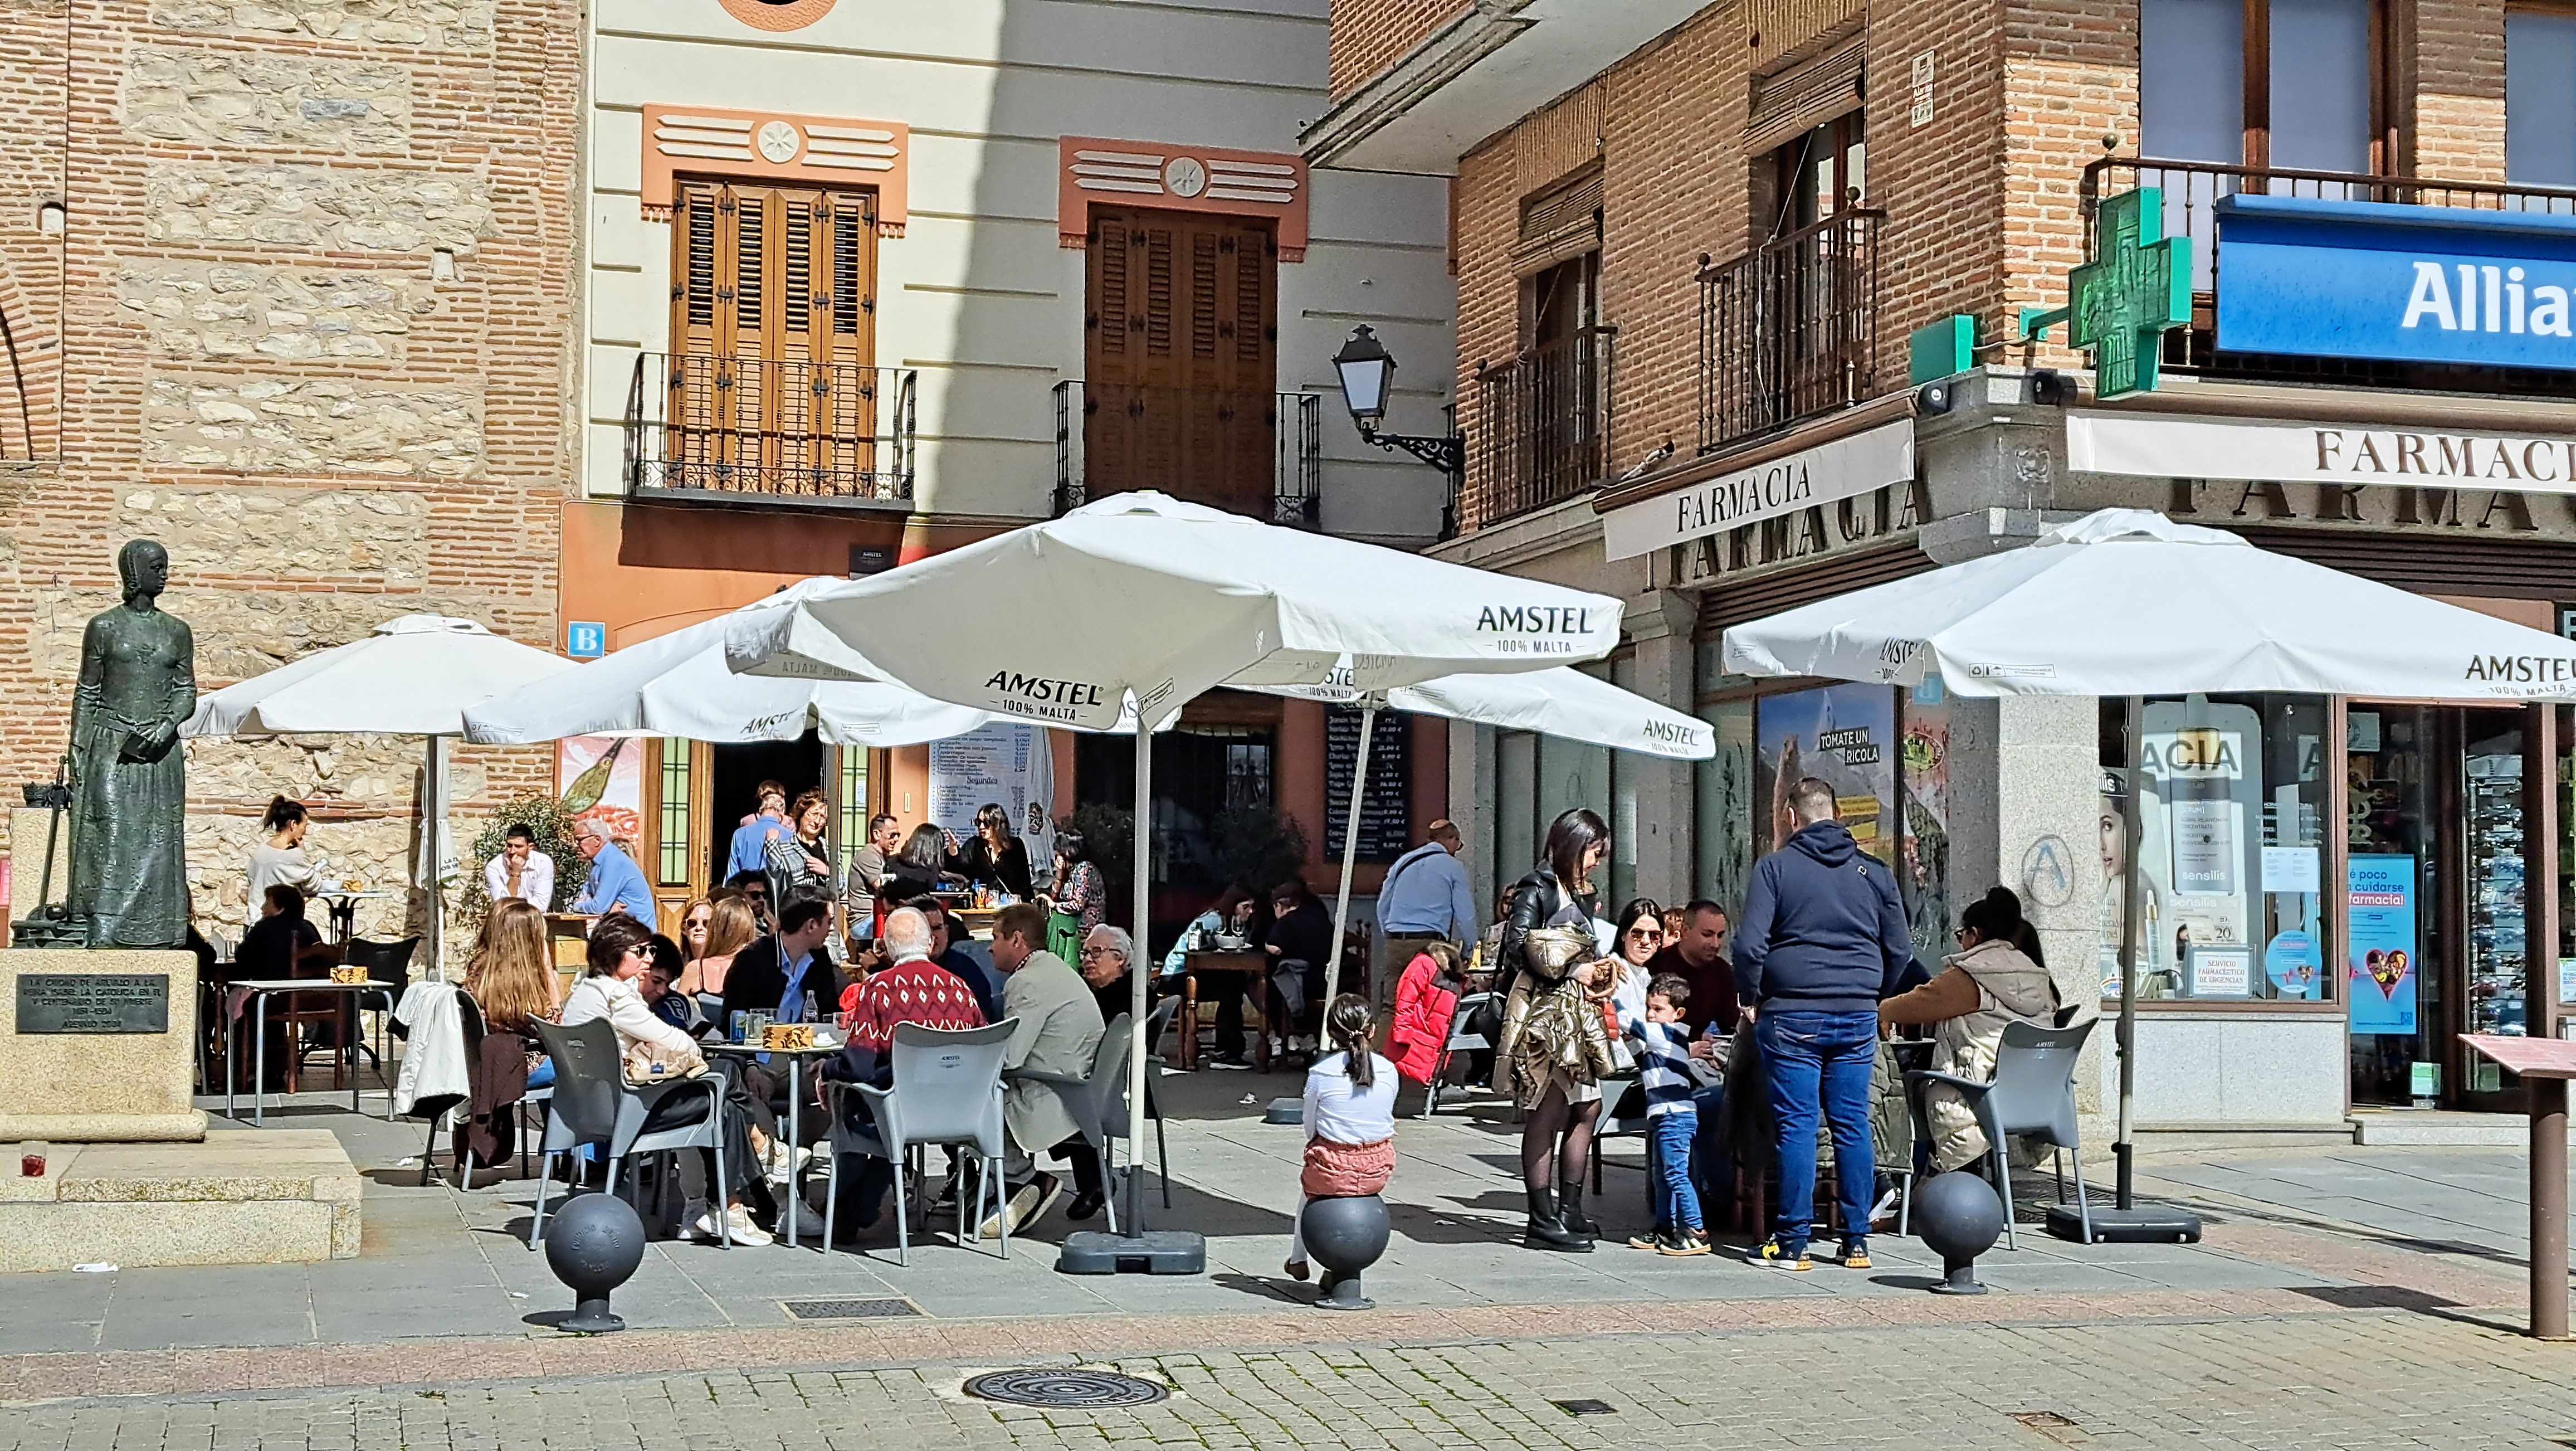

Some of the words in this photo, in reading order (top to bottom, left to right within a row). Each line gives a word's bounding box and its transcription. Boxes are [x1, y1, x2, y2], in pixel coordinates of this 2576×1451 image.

[2402, 261, 2576, 337] Allia
[1677, 460, 1811, 533] FARMACIA
[2169, 478, 2576, 531] FARMA
[1477, 606, 1594, 634] AMSTEL
[575, 628, 597, 650] B
[1497, 640, 1528, 653] 100%
[1534, 641, 1572, 653] MALTA
[984, 670, 1102, 707] AMSTEL
[1003, 699, 1033, 714] 100%
[1039, 705, 1076, 721] MALTA
[1643, 718, 1699, 746] AMSTEL
[1856, 730, 1868, 744] UN
[1846, 747, 1879, 763] RICOLA
[2141, 740, 2240, 773] ACIA
[2099, 773, 2116, 792] ilis
[2183, 868, 2226, 880] sensilis
[2359, 871, 2387, 881] poco
[2355, 882, 2404, 892] cuidarse
